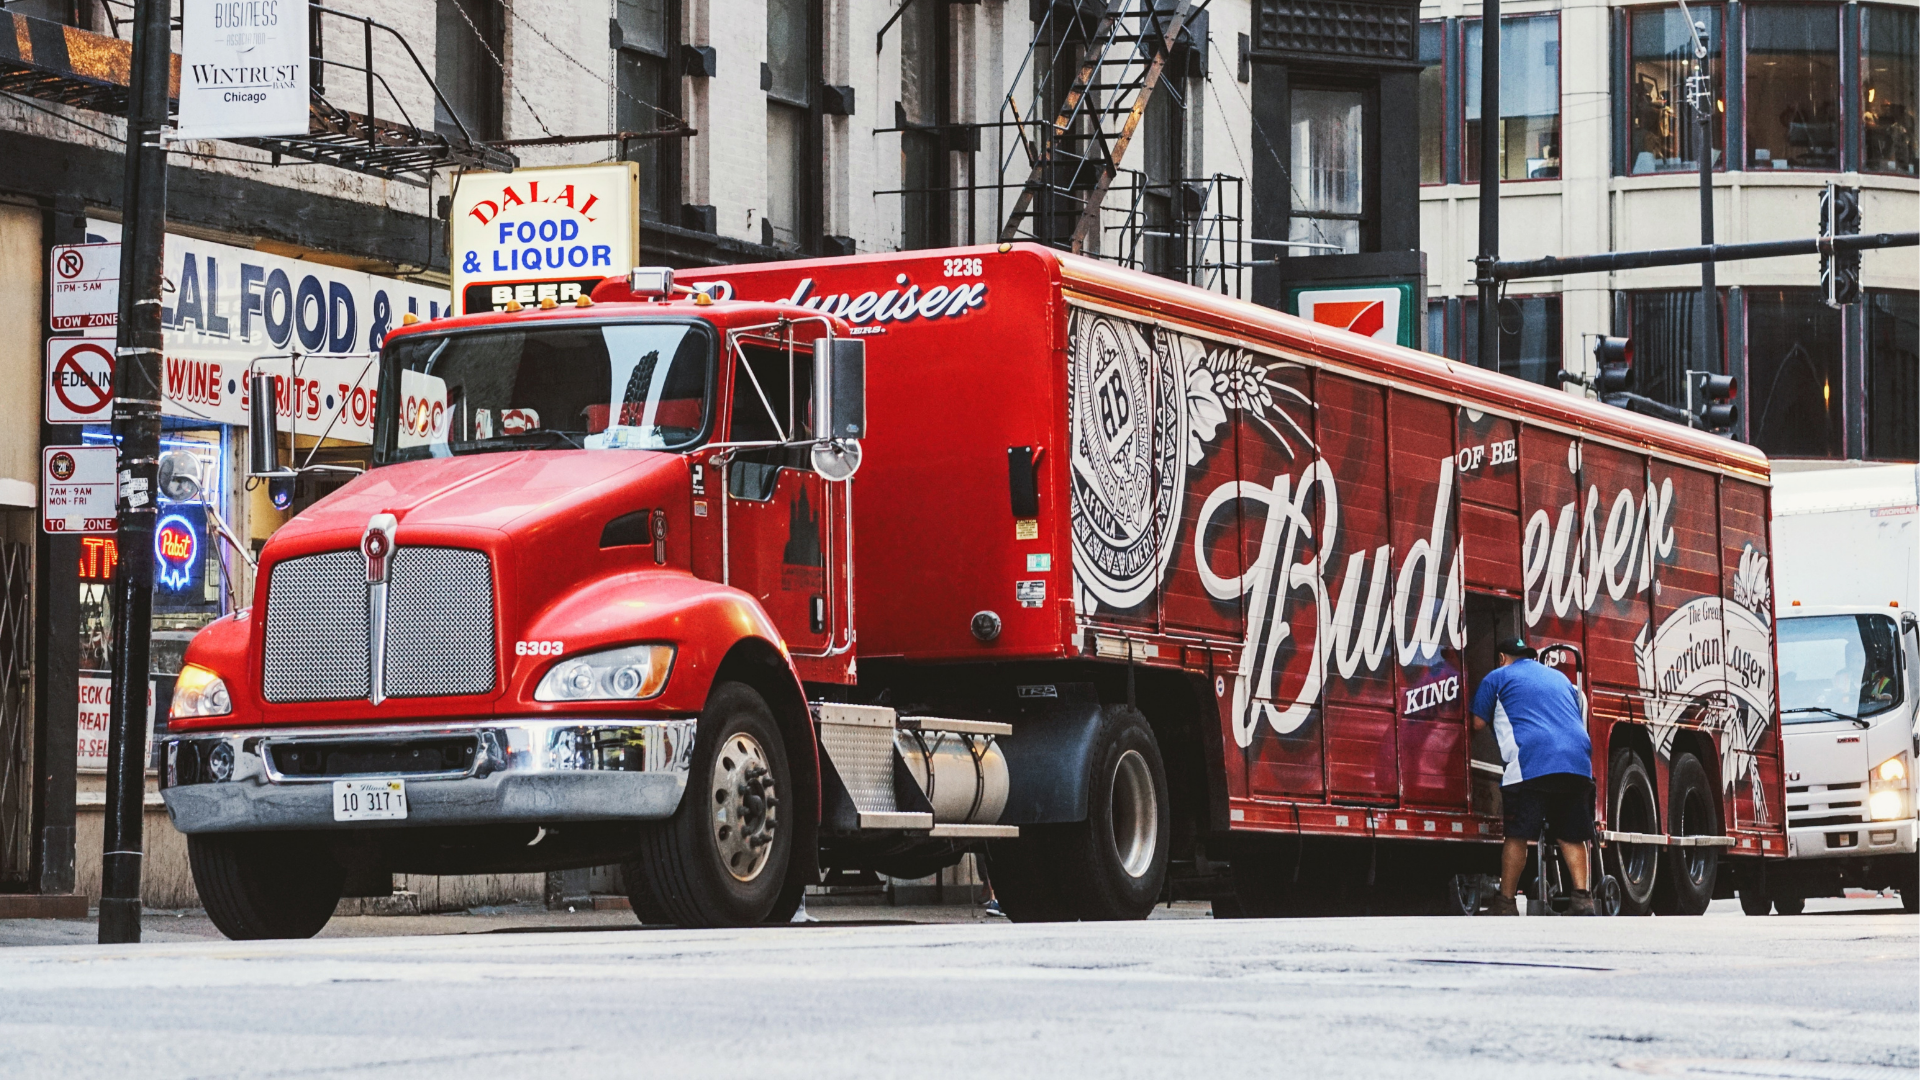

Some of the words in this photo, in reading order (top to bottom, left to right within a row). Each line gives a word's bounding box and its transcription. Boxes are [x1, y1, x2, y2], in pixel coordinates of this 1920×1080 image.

[215, 0, 278, 28] BUSINESS
[192, 64, 299, 85] WINTRUST
[272, 80, 297, 89] BANK
[223, 92, 267, 104] Chicago
[468, 181, 600, 227] DALAL
[499, 219, 579, 245] FOOD
[462, 250, 482, 274] &
[493, 244, 612, 272] LIQUOR
[943, 257, 983, 277] 3236
[491, 282, 582, 304] BEER
[239, 262, 358, 355] FOOD
[57, 316, 82, 328] TOW
[87, 314, 119, 326] ZONE
[51, 371, 112, 388] PEDDLIN
[166, 356, 223, 407] WINE
[241, 369, 321, 421] SRITS
[1459, 445, 1484, 472] OF
[50, 487, 67, 496] 7AM
[73, 487, 92, 496] 9AM
[50, 497, 67, 505] MON
[73, 497, 87, 505] FRI
[1083, 486, 1116, 539] AFRICA
[50, 520, 67, 531] TO
[83, 519, 112, 531] ZONE
[161, 529, 191, 559] Pabst
[1688, 604, 1701, 626] The
[515, 640, 564, 656] 6303
[1725, 629, 1766, 690] Lager
[1404, 675, 1459, 715] KING
[79, 711, 109, 731] REAT
[342, 792, 359, 812] 10
[366, 792, 390, 811] 317
[396, 794, 402, 807] T
